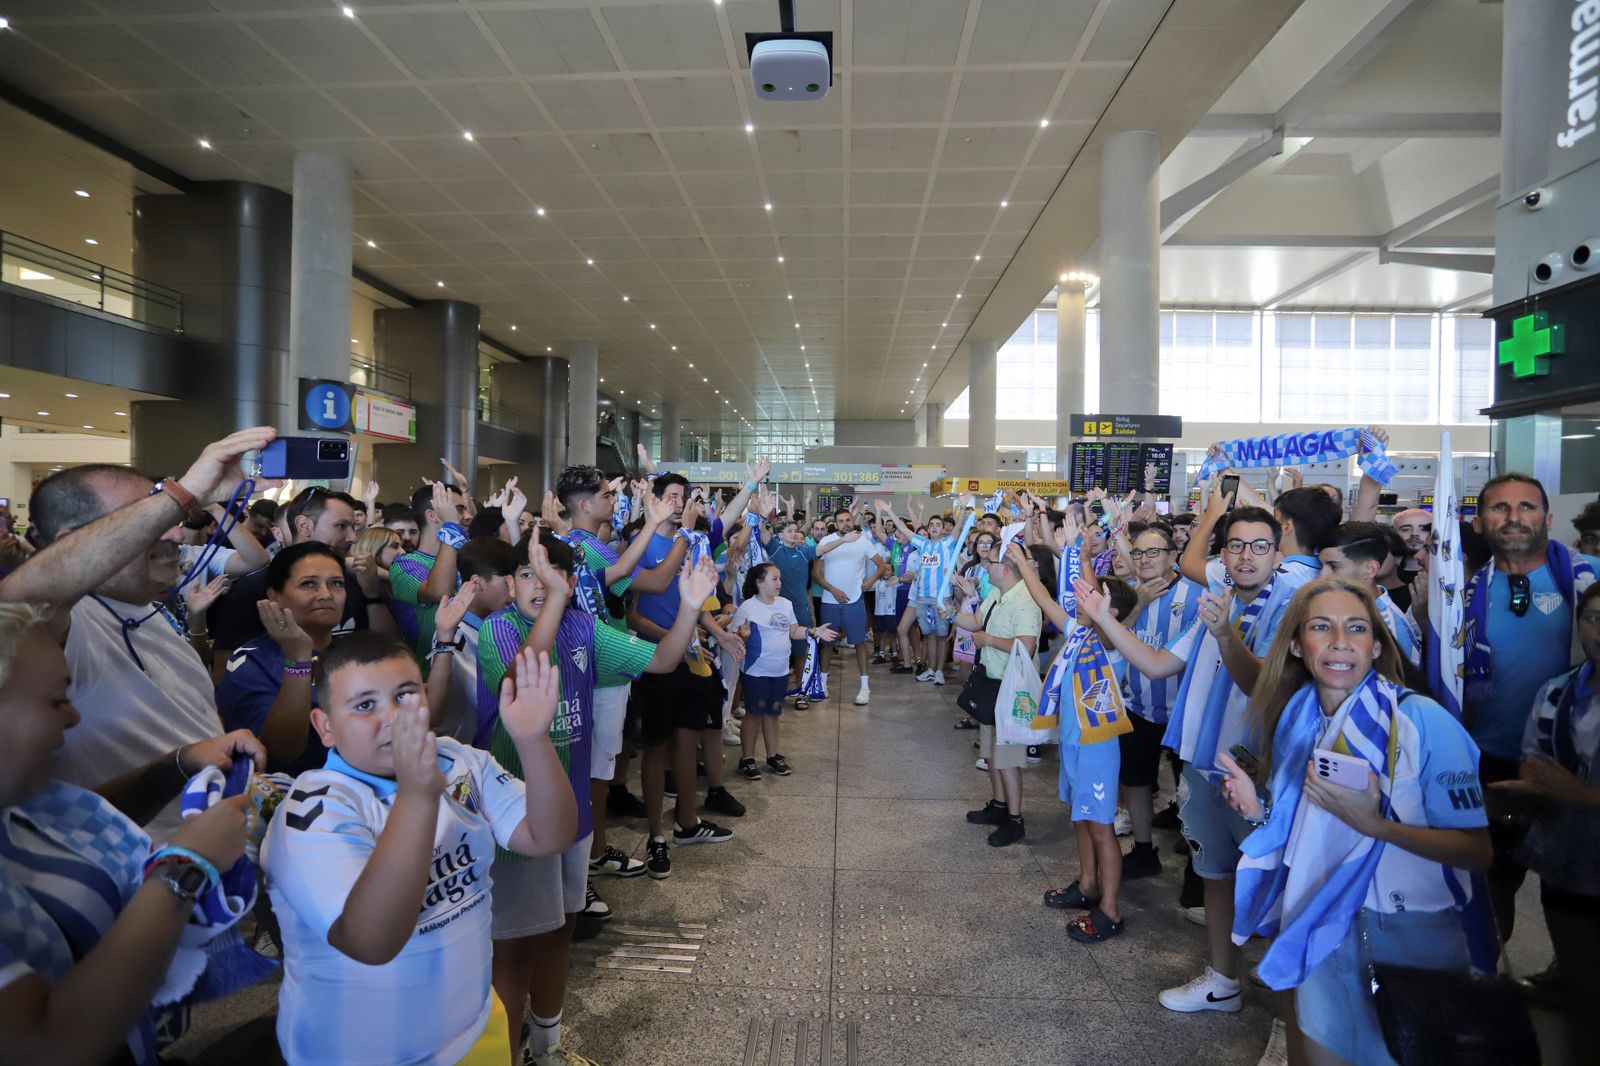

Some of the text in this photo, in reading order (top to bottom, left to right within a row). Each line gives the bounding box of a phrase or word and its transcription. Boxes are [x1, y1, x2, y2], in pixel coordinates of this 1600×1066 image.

[1557, 0, 1600, 147] farma
[1237, 431, 1340, 462] MALAGA
[719, 471, 738, 480] 001
[833, 472, 853, 482] 301
[858, 472, 880, 482] 386
[419, 893, 486, 936] Málaga es Provincia
